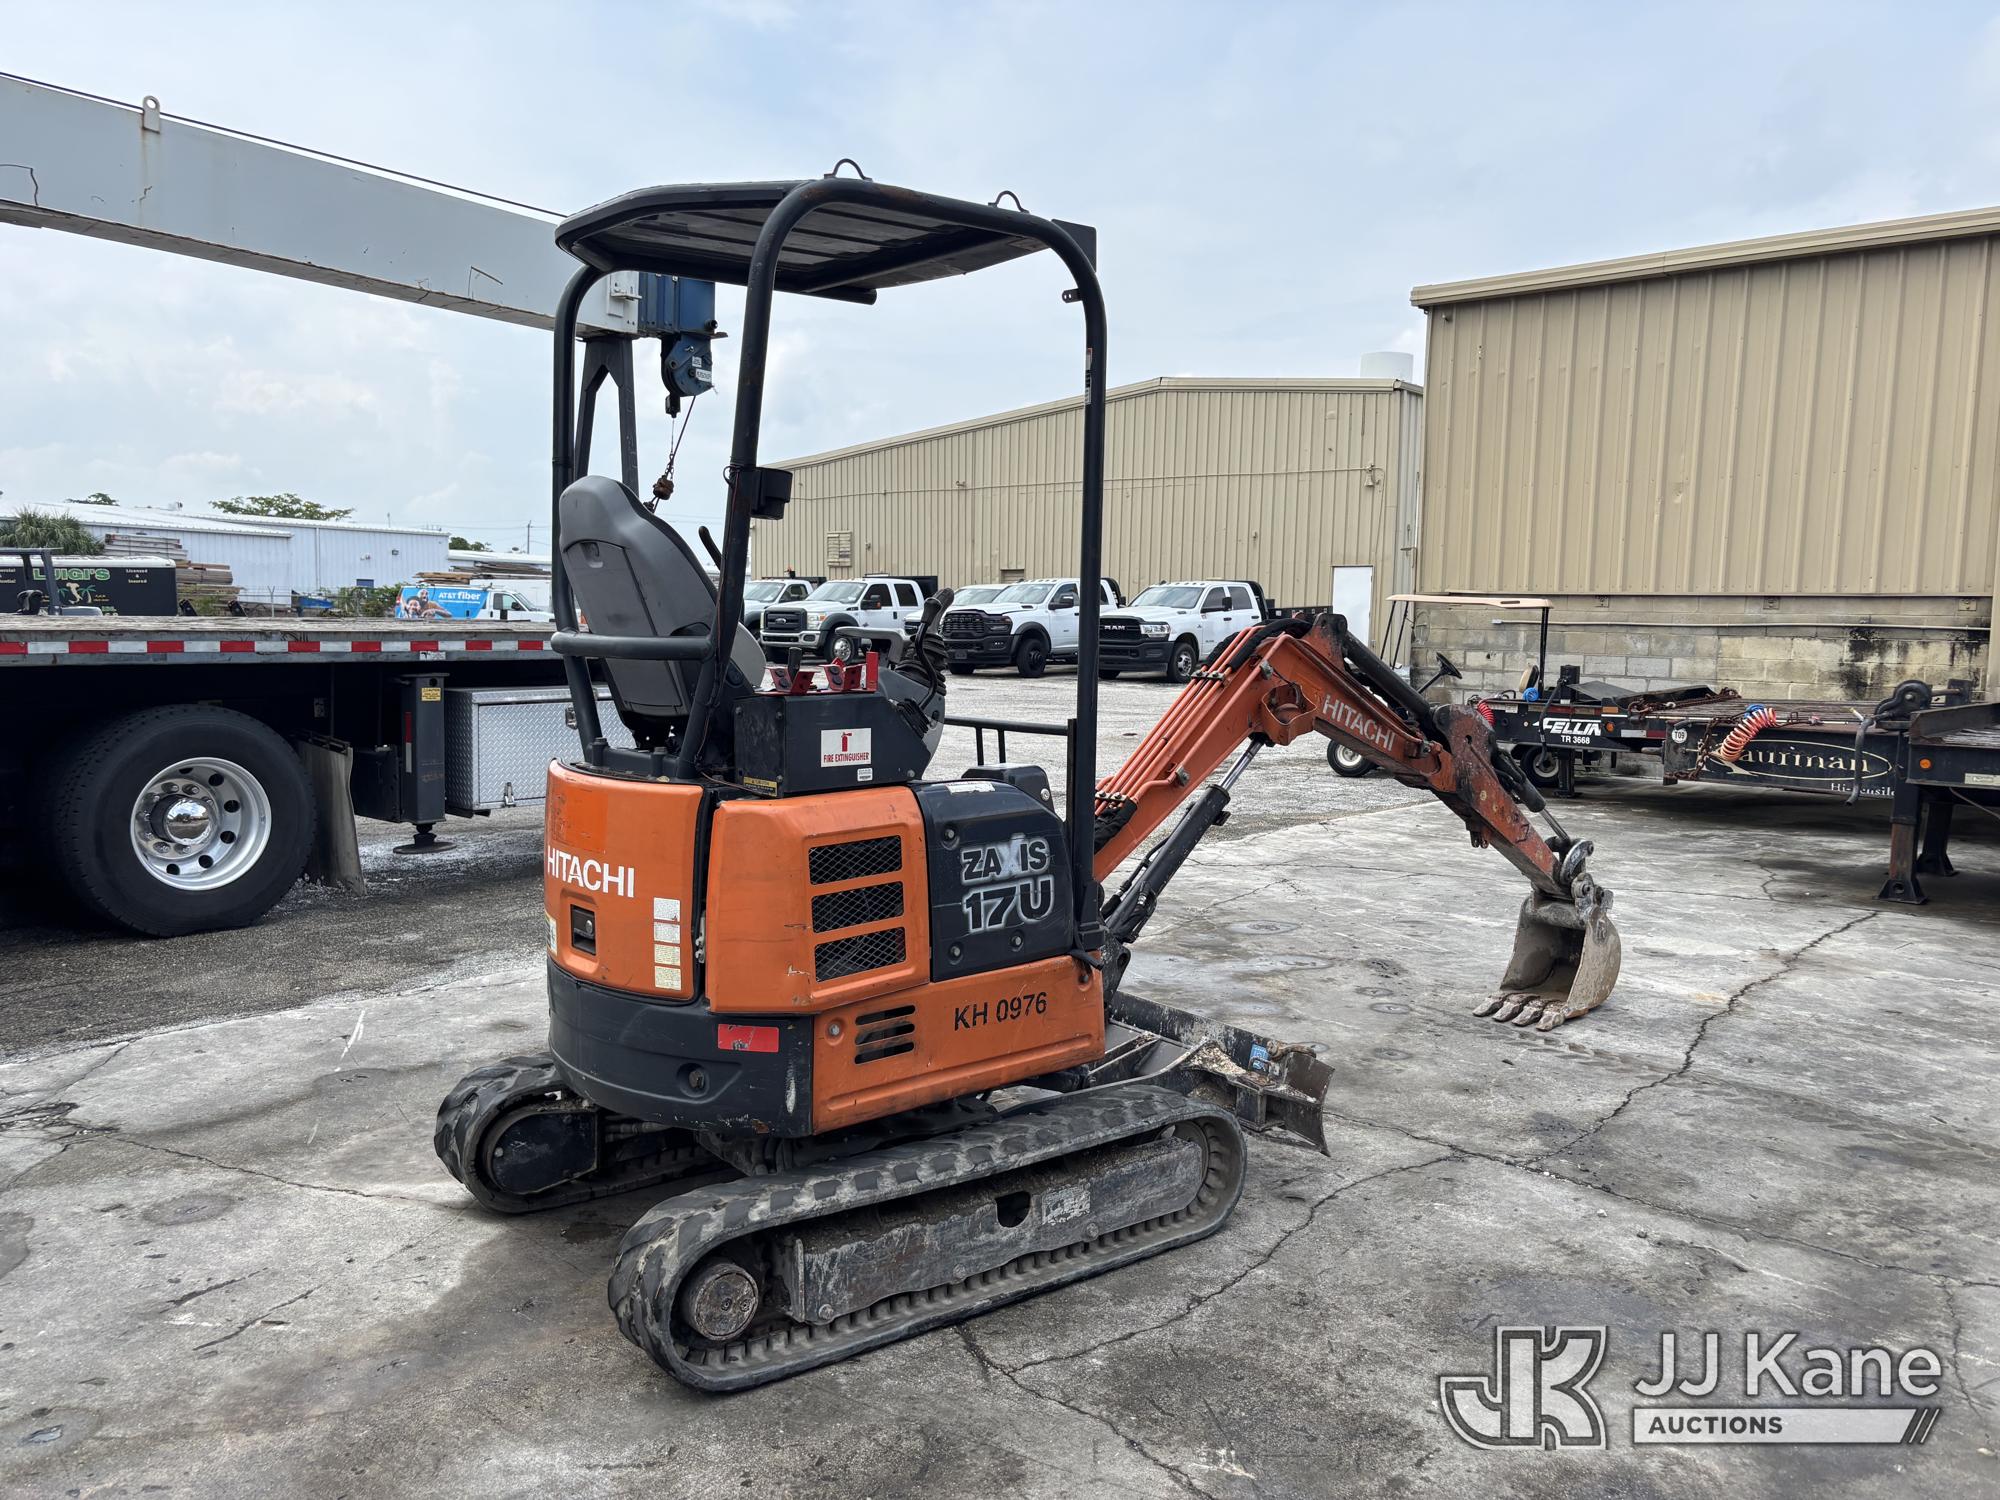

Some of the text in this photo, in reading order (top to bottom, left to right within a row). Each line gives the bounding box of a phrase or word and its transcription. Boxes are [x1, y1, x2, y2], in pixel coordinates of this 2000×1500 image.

[457, 591, 481, 600] fiber
[1322, 694, 1396, 752] HITACHI
[1560, 735, 1572, 743] TR
[823, 752, 870, 763] FIRE EXTINGUISHER
[546, 845, 635, 898] HITACHI
[963, 876, 1055, 933] 17U
[954, 991, 1047, 1031] KH 0976
